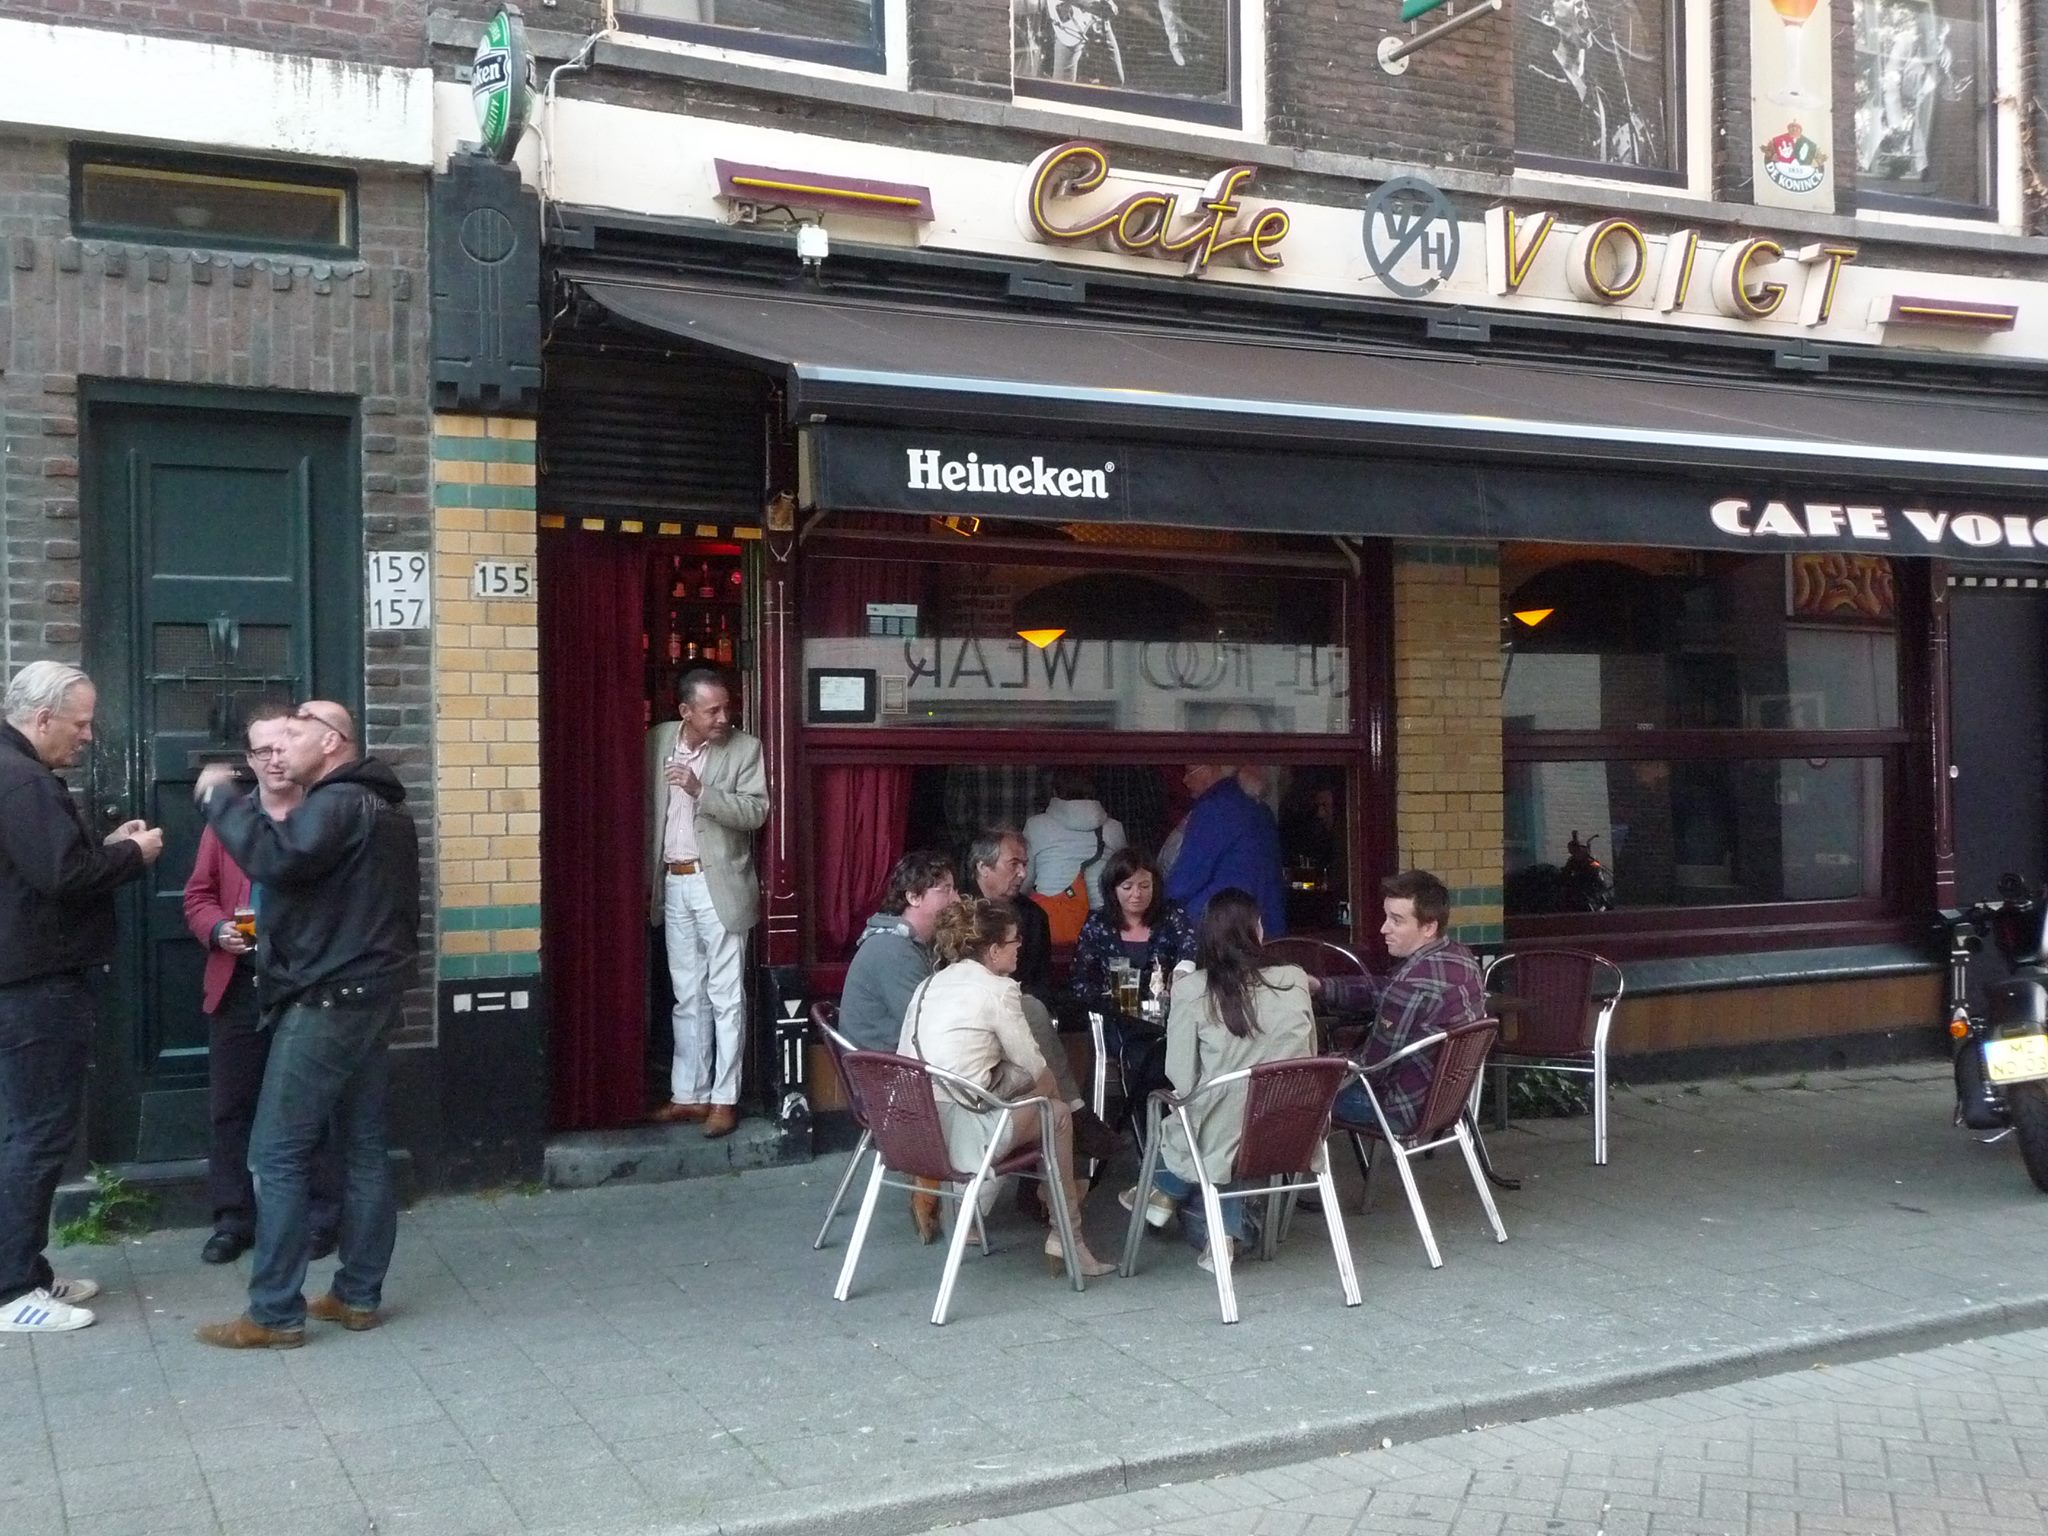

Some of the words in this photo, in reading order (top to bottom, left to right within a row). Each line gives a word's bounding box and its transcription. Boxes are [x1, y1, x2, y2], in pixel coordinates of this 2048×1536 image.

[1766, 161, 1780, 181] DE
[1779, 168, 1823, 191] KONINCK
[1486, 205, 1859, 328] VOIGT
[906, 449, 1110, 499] Heineken
[1710, 499, 1892, 541] CAFE
[372, 556, 426, 583] 159
[478, 566, 530, 593] 155
[374, 599, 425, 626] 157
